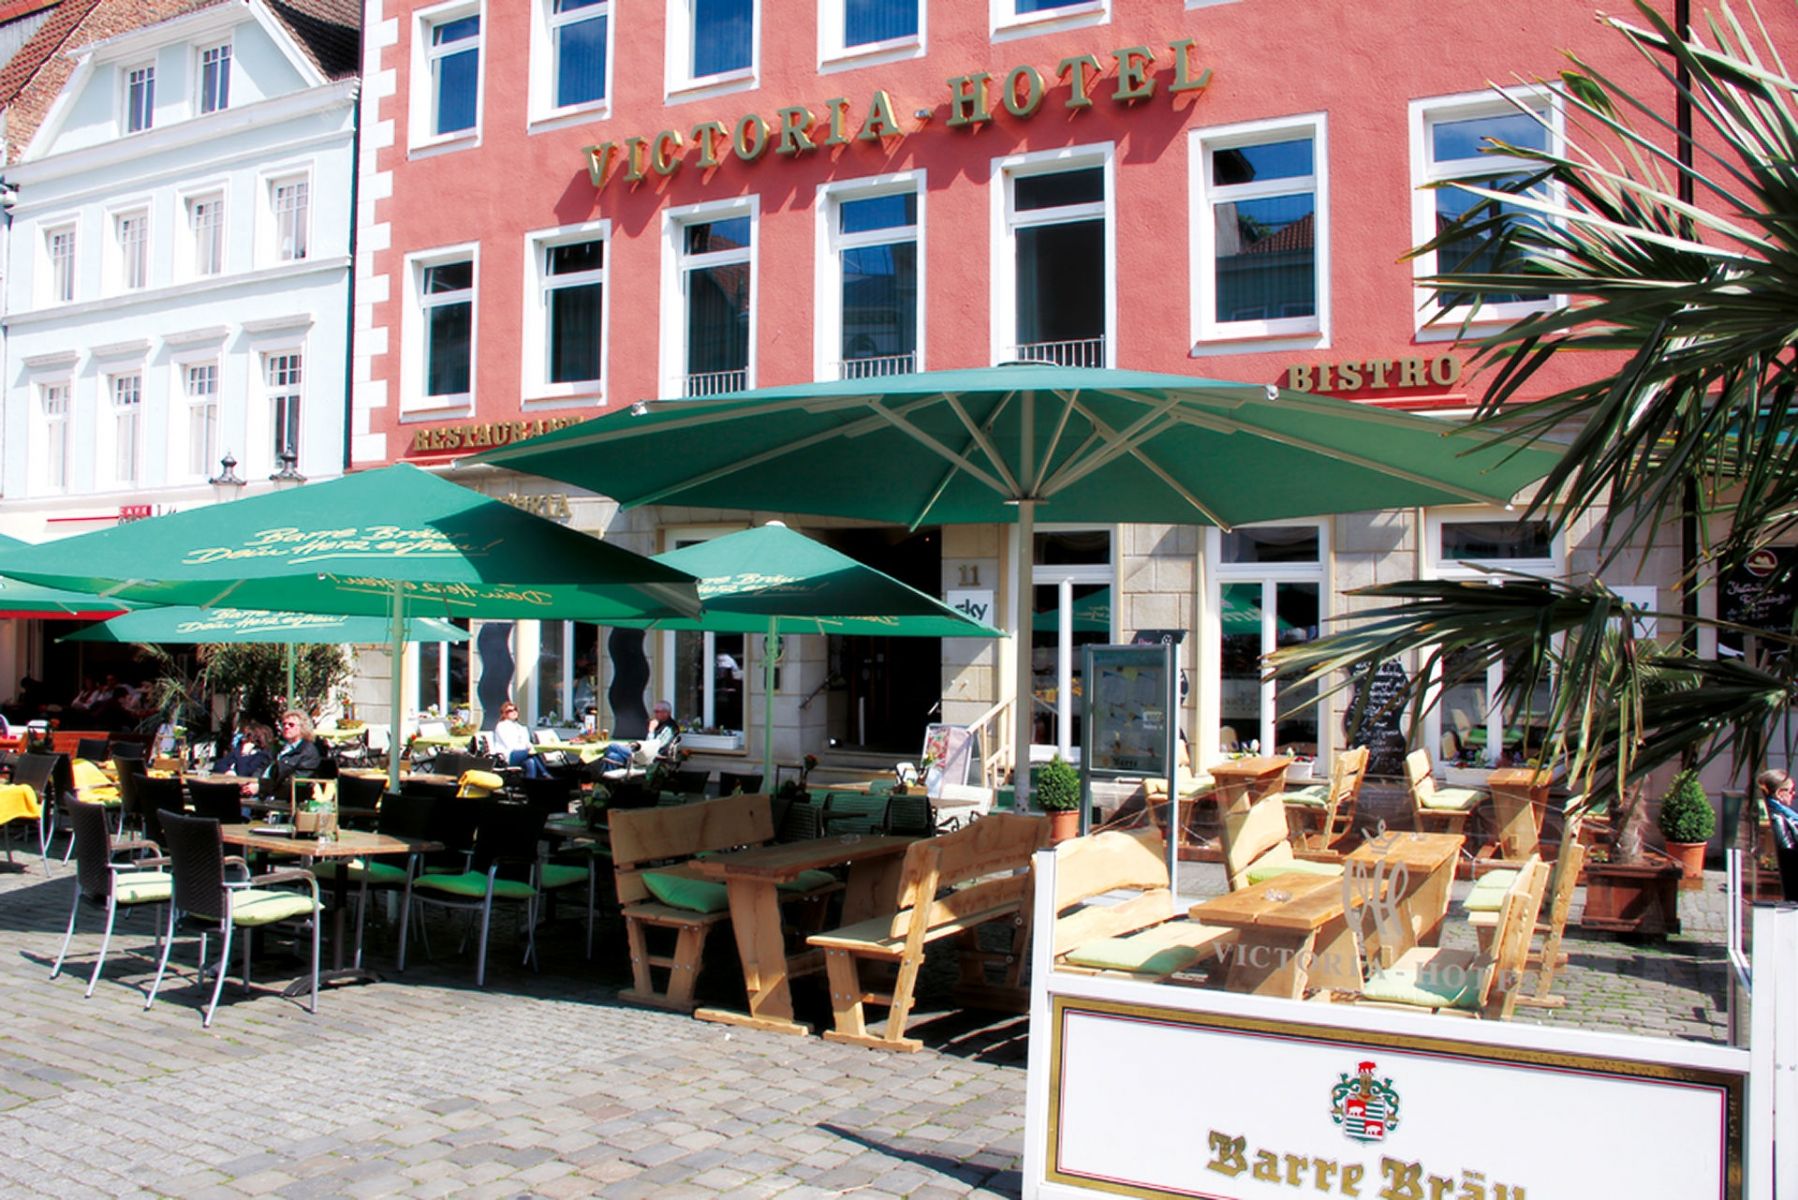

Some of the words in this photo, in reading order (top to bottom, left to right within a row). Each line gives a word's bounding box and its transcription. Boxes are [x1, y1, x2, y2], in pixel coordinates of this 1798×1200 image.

[1288, 353, 1462, 393] BISTRO
[244, 527, 357, 546] Barre
[181, 547, 290, 564] Dein
[958, 564, 981, 587] 11
[1206, 1129, 1364, 1197] Barre
[1380, 1155, 1526, 1200] Bräu
